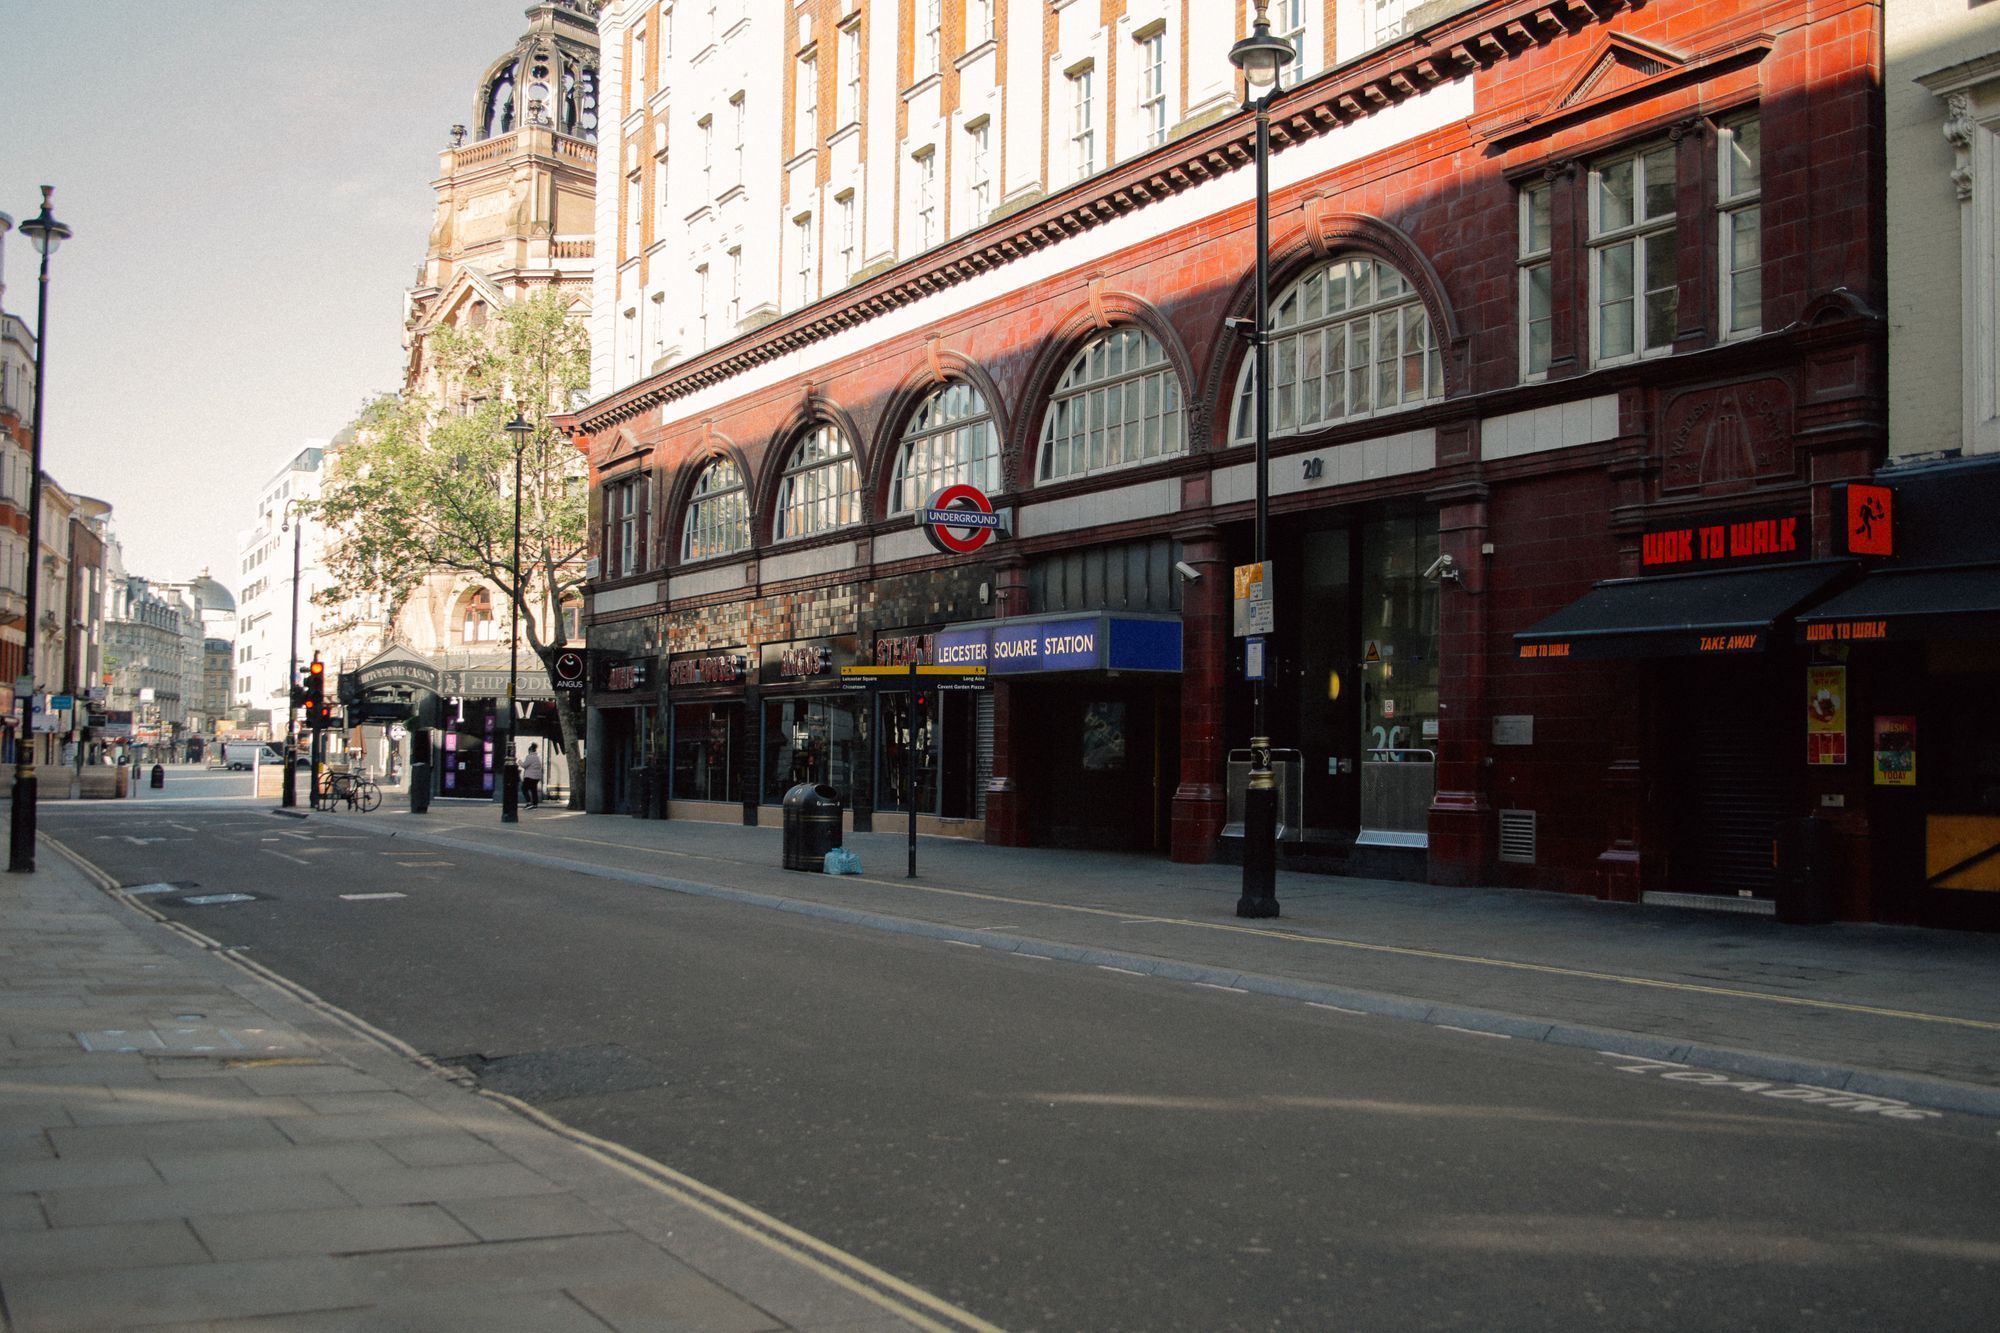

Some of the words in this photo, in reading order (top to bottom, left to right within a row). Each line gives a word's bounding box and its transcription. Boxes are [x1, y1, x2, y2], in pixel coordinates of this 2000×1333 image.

[1303, 457, 1322, 480] 20
[928, 511, 997, 525] UNDERGROUND
[1642, 529, 1692, 566] WOK
[1700, 526, 1725, 560] TO
[1730, 517, 1796, 557] WALK
[1807, 624, 1834, 640] WOK
[1835, 624, 1850, 639] TO
[1852, 621, 1886, 638] WALK
[876, 634, 919, 667] STEAK
[938, 643, 988, 663] LEICESTER
[994, 639, 1037, 658] SQUARE
[1045, 634, 1093, 655] STATION
[1520, 645, 1537, 658] WOK
[1538, 645, 1549, 657] TO
[1549, 644, 1569, 656] WALK
[1700, 636, 1725, 650] TAKE
[1727, 635, 1757, 649] AWAY
[781, 646, 820, 677] ANGUS
[472, 676, 552, 693] HIPPODR
[556, 679, 583, 689] ANGUS
